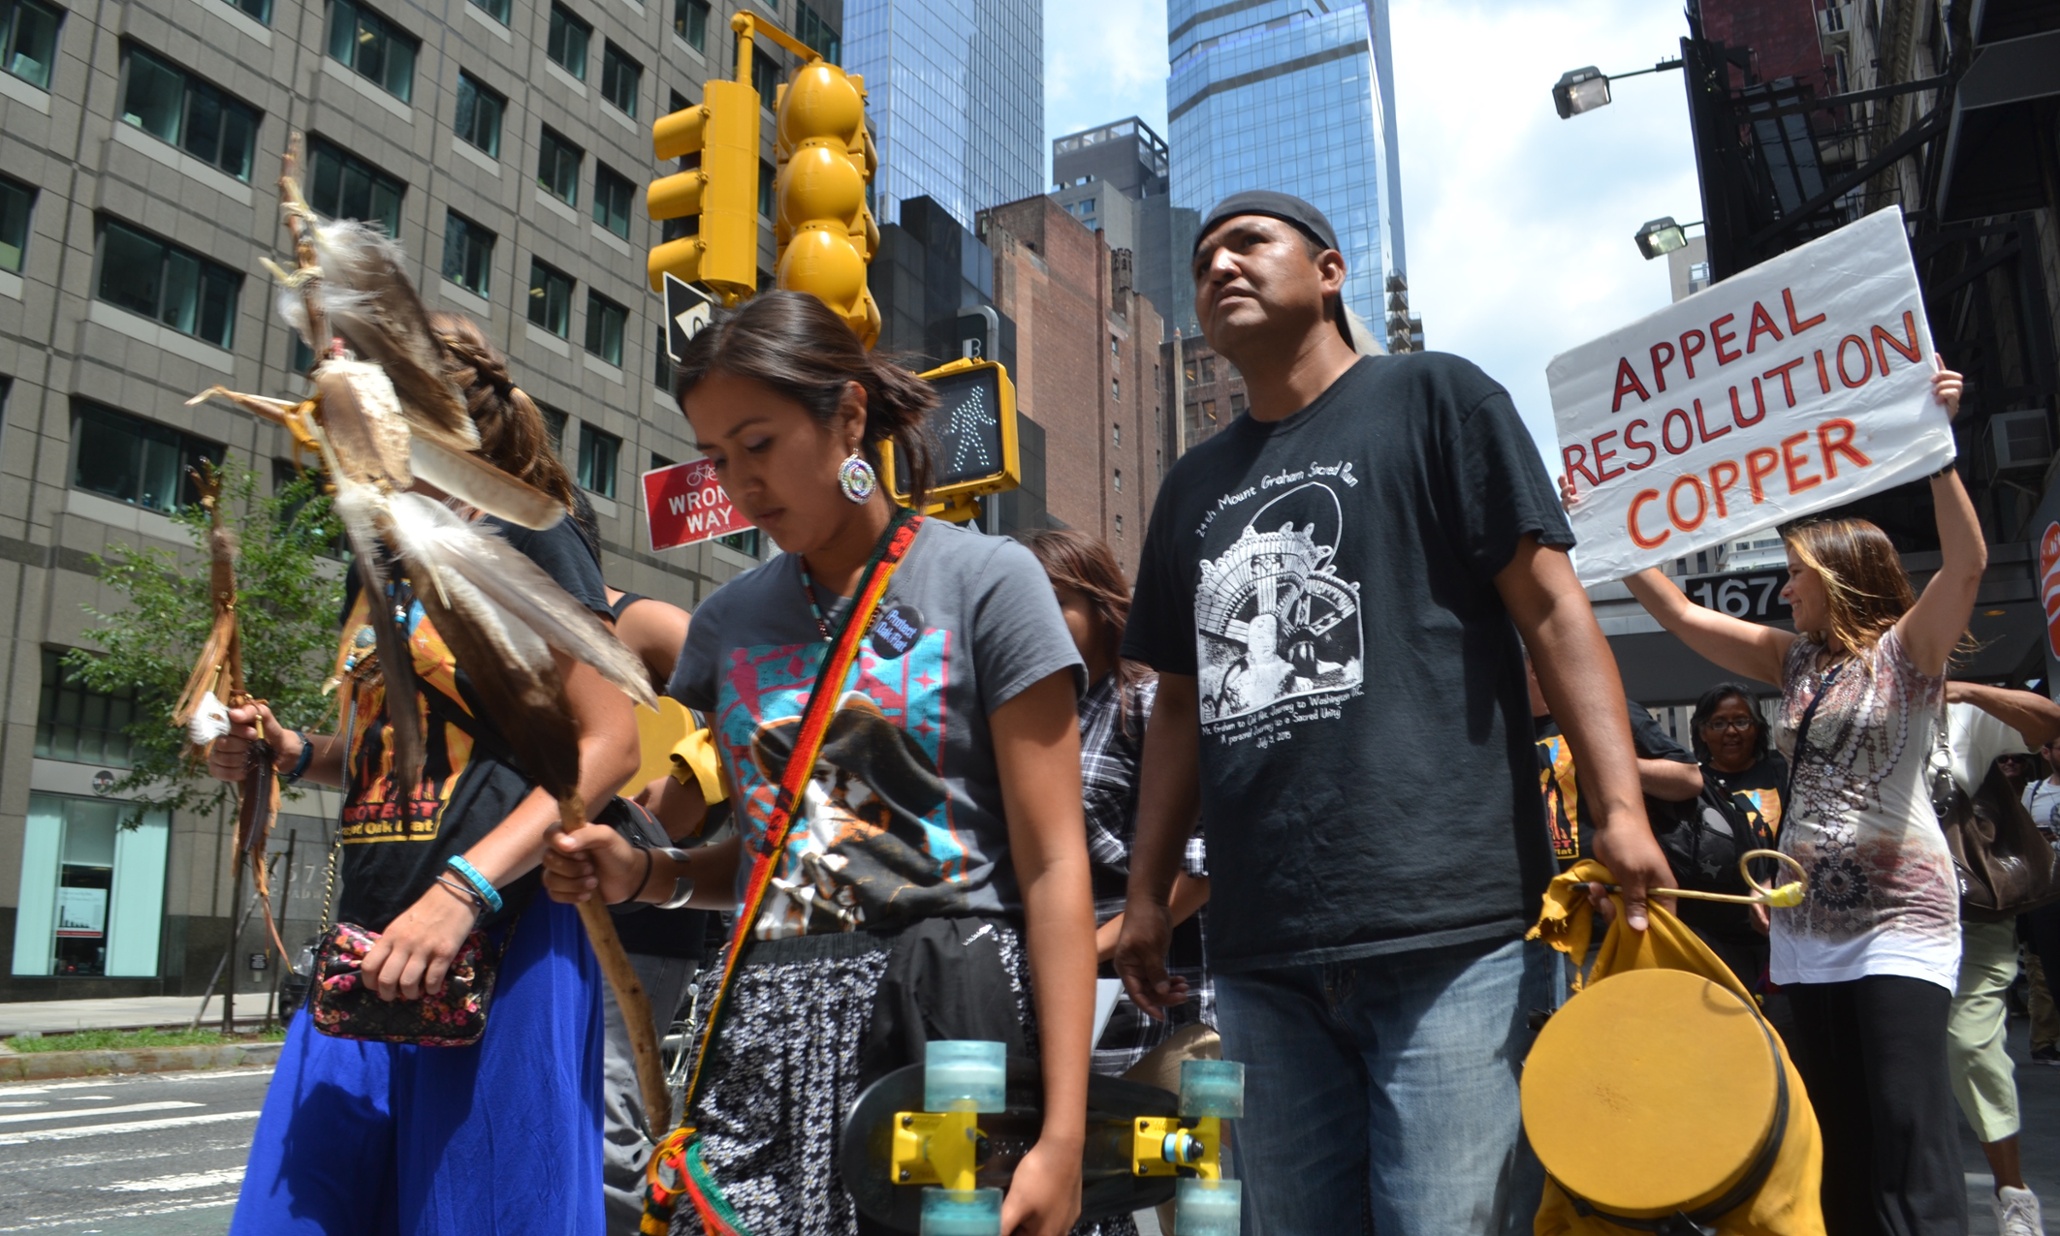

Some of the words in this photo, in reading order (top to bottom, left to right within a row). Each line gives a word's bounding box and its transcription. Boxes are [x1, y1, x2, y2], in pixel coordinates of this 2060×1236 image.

[1611, 287, 1827, 414] APPEAL
[1562, 310, 1922, 495] RESOLUTION
[1217, 486, 1257, 510] Mount
[1260, 468, 1305, 490] Graham
[1307, 460, 1343, 478] Sacred
[1626, 417, 1873, 550] COPPER
[668, 484, 732, 516] WRON
[686, 504, 733, 534] WAY
[1693, 576, 1790, 619] 167
[875, 621, 893, 642] Oak
[890, 632, 908, 653] Flat
[885, 609, 918, 639] Protect
[1292, 708, 1319, 723] Sacred
[1308, 693, 1350, 706] Washington
[344, 801, 439, 821] ROTECT
